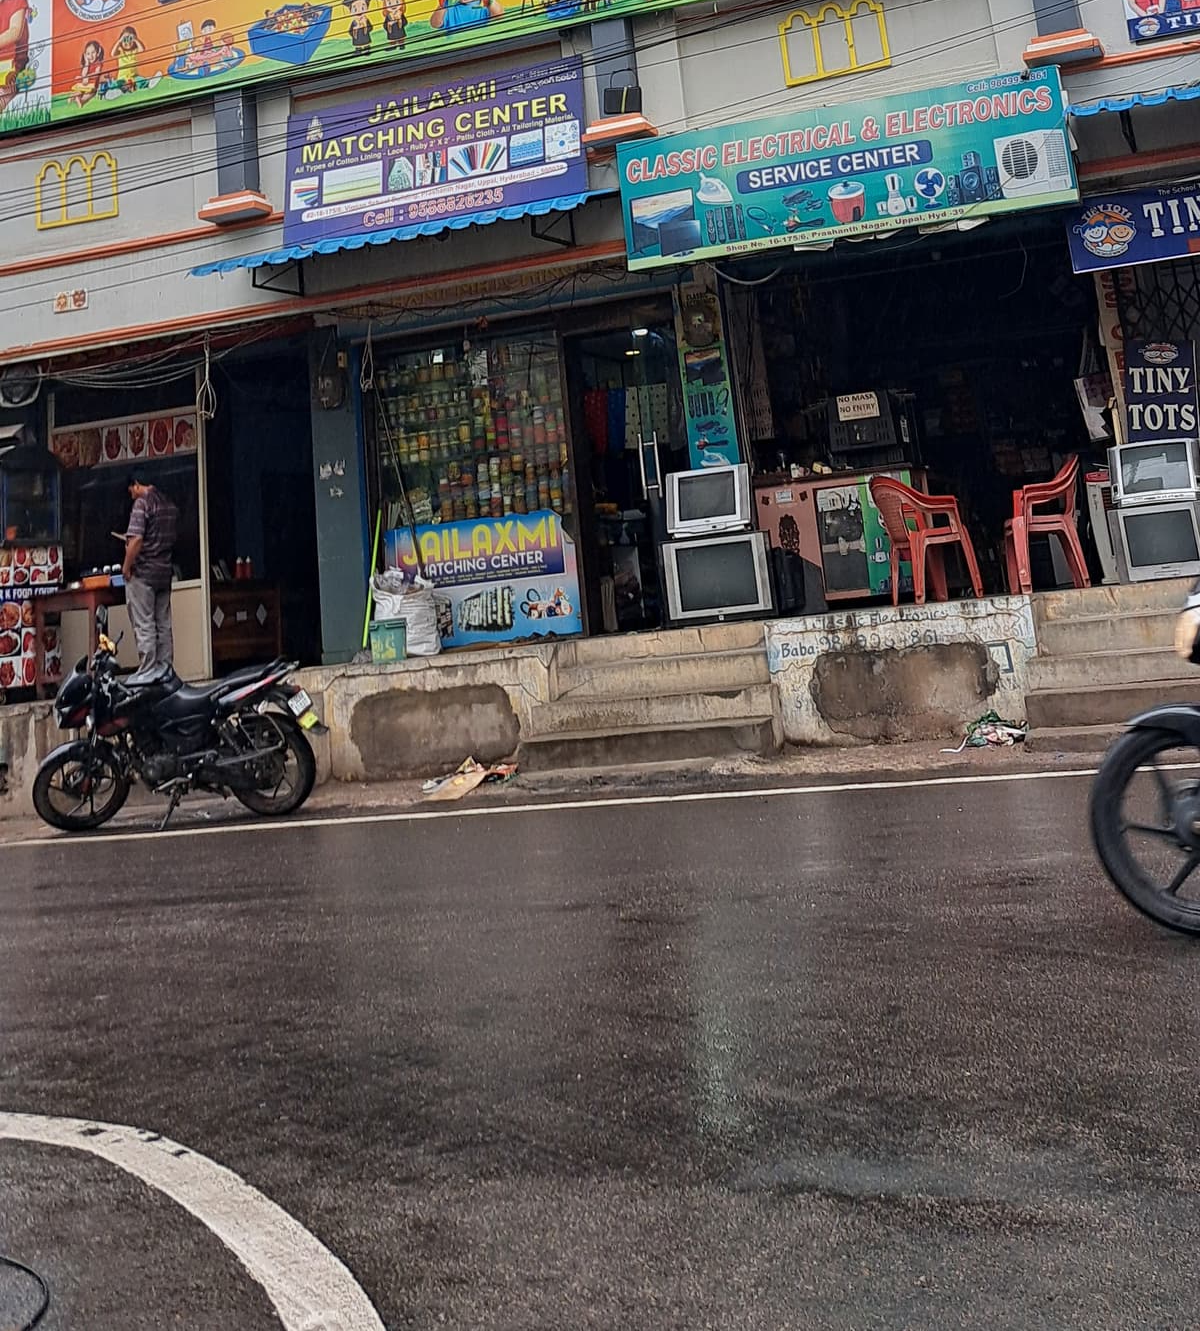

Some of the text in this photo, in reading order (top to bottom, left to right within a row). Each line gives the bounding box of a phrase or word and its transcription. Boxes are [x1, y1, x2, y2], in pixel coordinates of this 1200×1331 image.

[368, 80, 496, 124] JAILAXMI
[967, 70, 1048, 94] Cell: 98499861
[301, 93, 568, 164] MATCHING CENTER
[306, 162, 326, 173] Types
[327, 160, 335, 168] of
[336, 156, 359, 167] Cotton
[360, 151, 382, 162] Lining
[476, 129, 495, 139] Cloth
[512, 119, 543, 131] Tailoring
[626, 86, 1053, 184] CLASSIC ELECTRICAL & ELECTRONICS
[748, 143, 921, 189] SERVICE CENTER
[362, 207, 394, 228] Cell
[726, 241, 749, 253] Shop
[811, 225, 859, 239] Prashanth
[860, 220, 893, 232] Nagar,
[894, 214, 927, 227] Uppal,
[928, 209, 944, 221] Hyd
[1129, 367, 1190, 394] TINY
[852, 403, 876, 412] ENTRY
[1129, 403, 1196, 431] TOTS
[403, 515, 558, 566] JAILAXMI
[491, 550, 544, 569] CENTER
